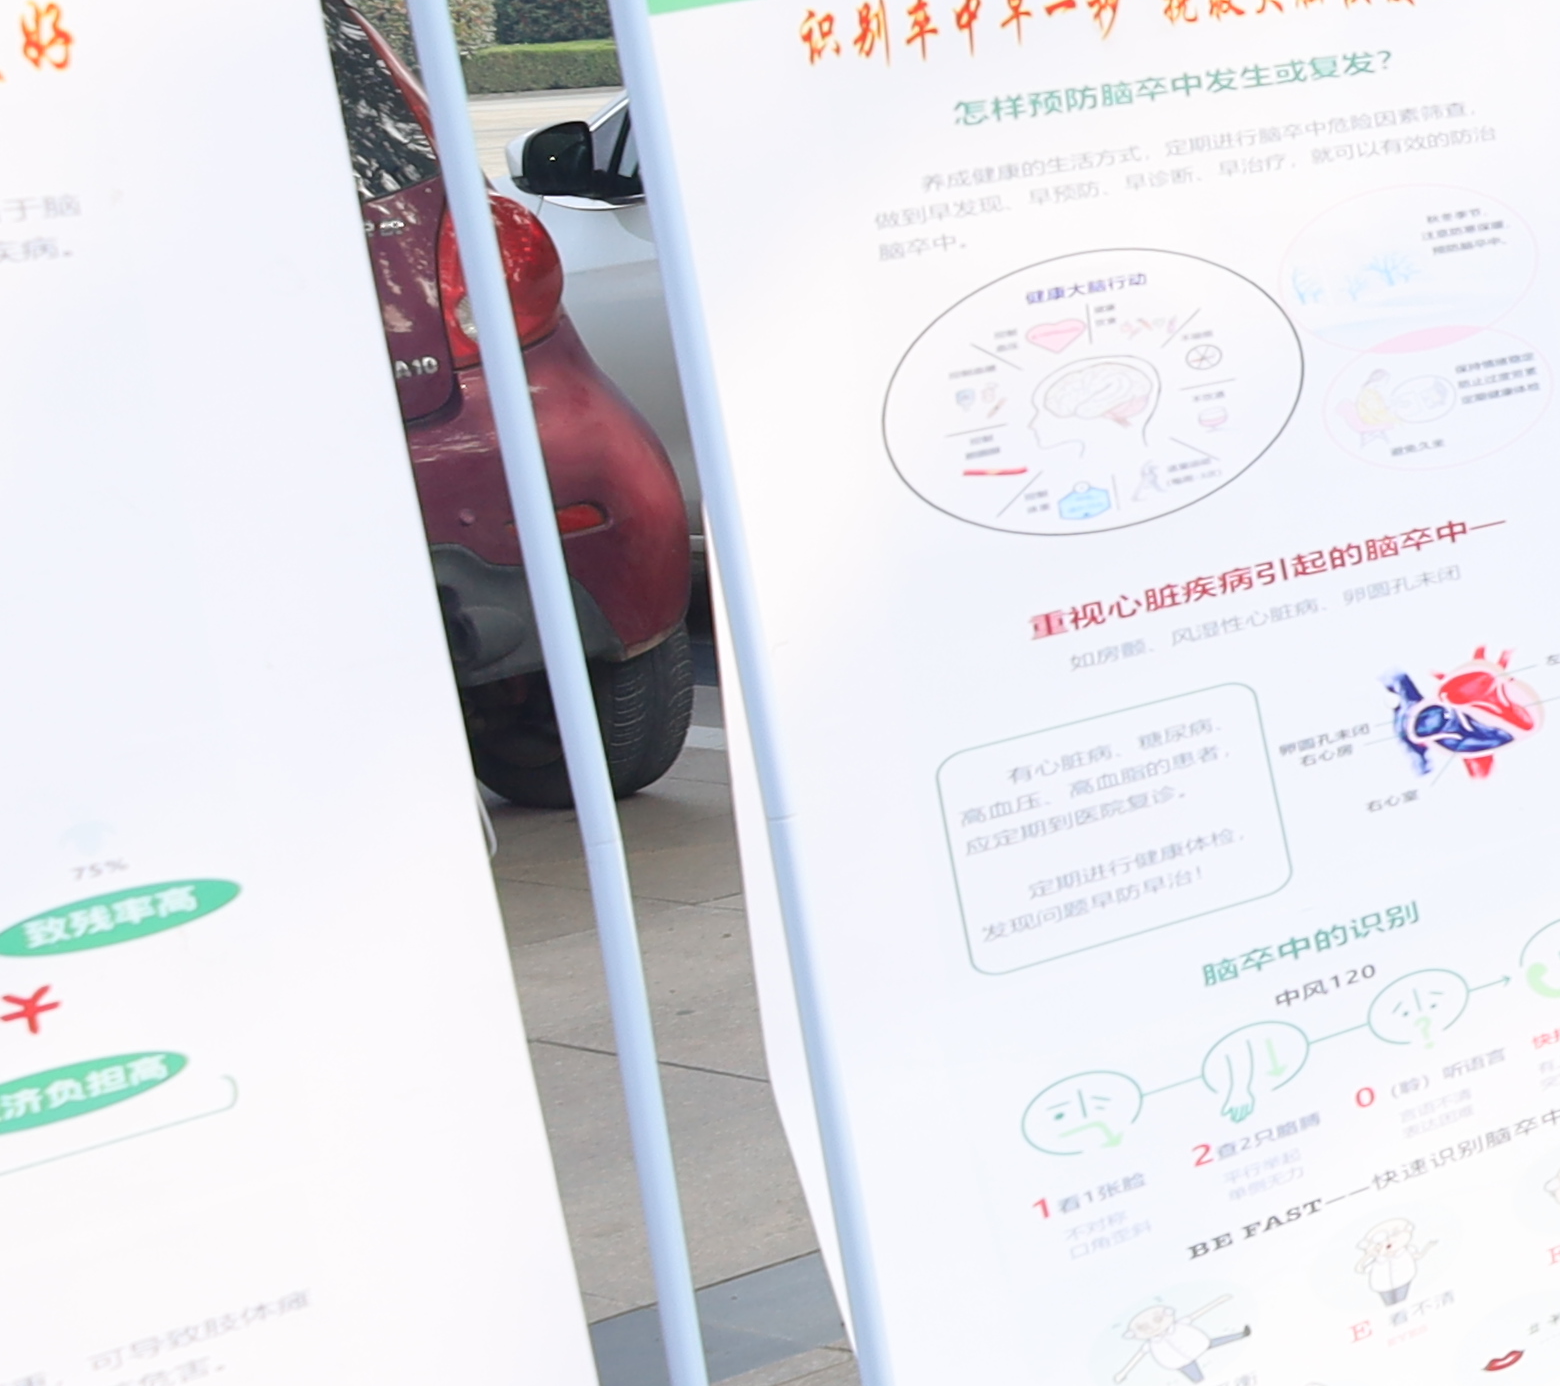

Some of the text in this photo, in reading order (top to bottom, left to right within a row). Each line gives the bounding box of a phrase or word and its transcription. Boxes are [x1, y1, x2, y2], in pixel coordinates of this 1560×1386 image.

[1024, 272, 1148, 305] 健康大脑行动
[22, 883, 199, 950] 致残率高
[1201, 899, 1420, 989] 脑卒中的识别
[1273, 963, 1377, 1009] 中风120
[1191, 1142, 1215, 1168] 2
[1032, 1196, 1052, 1220] 1
[1187, 1231, 1234, 1261] BE
[1347, 1288, 1457, 1345] E 看不清
